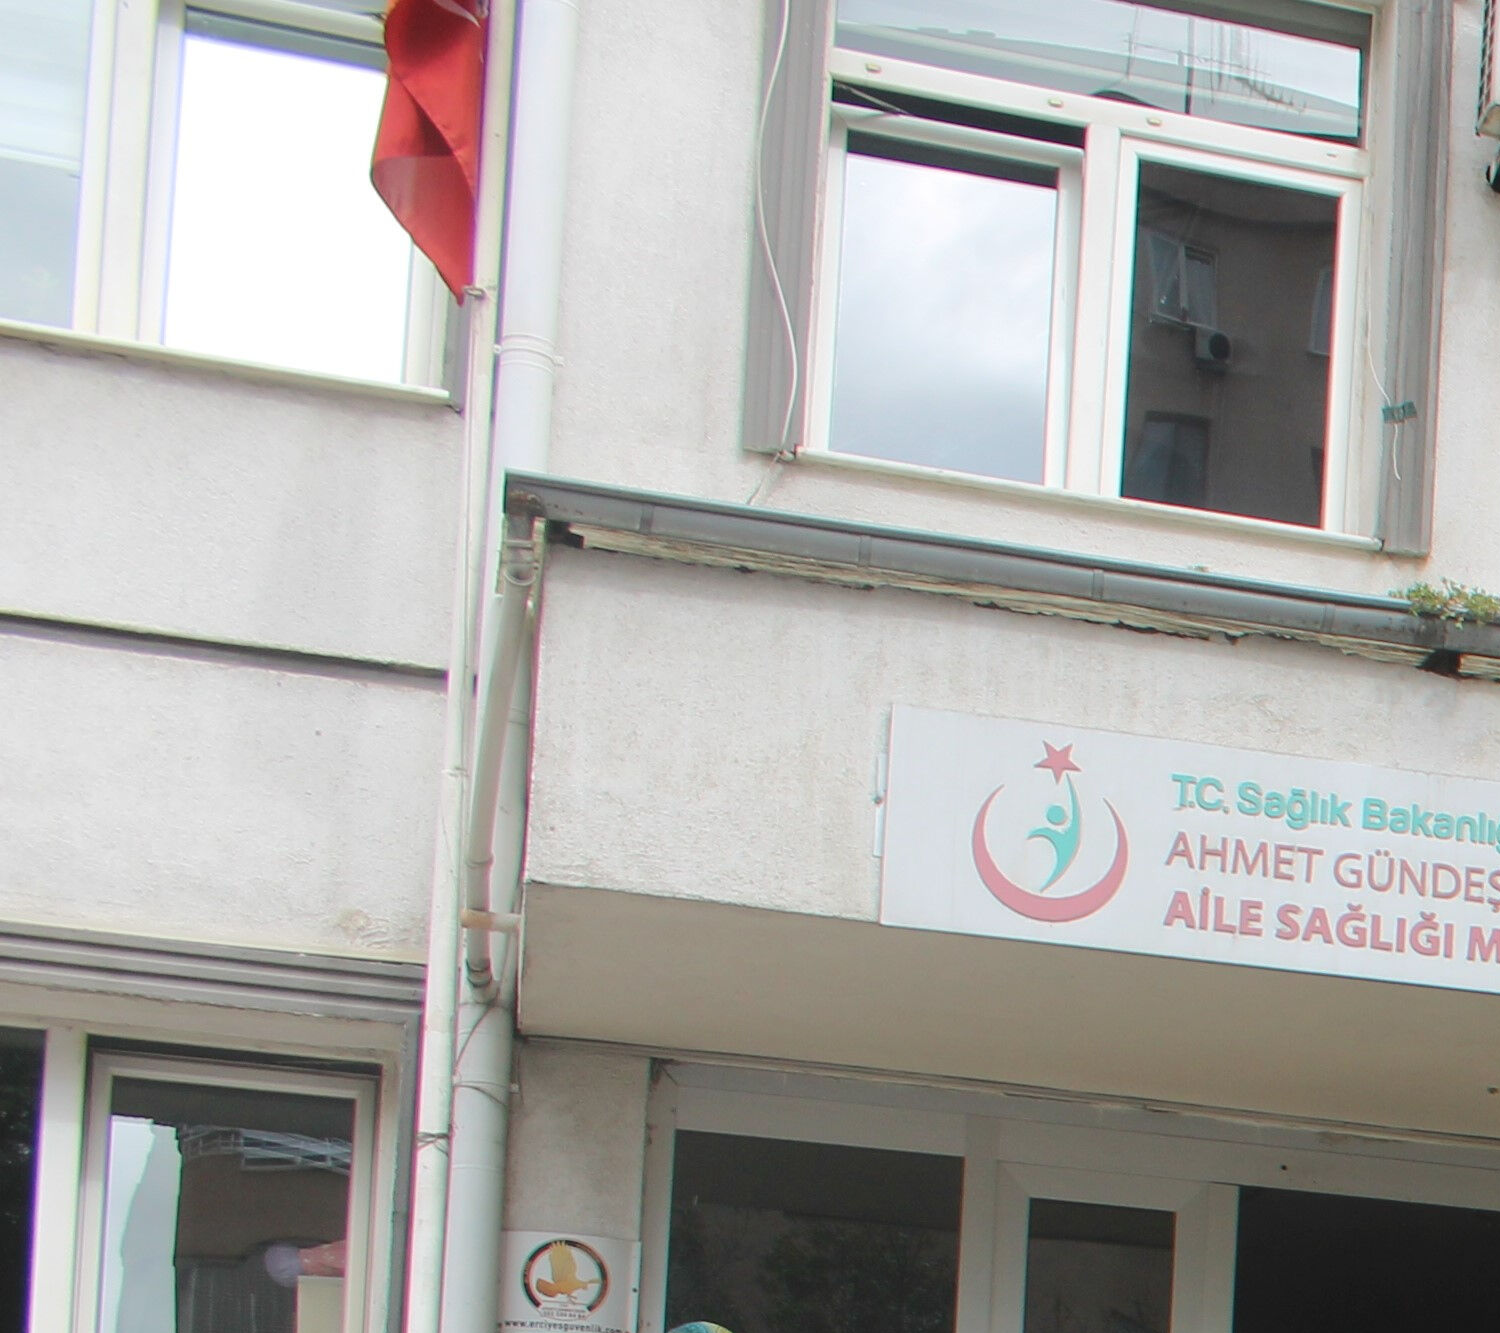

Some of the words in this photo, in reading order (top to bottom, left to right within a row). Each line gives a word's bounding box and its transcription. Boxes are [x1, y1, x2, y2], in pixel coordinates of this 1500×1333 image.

[1237, 781, 1352, 830] Sağlık
[1165, 831, 1325, 883] AHMET
[1163, 887, 1264, 936] AİLE
[1275, 903, 1455, 958] SAĞLIĞI
